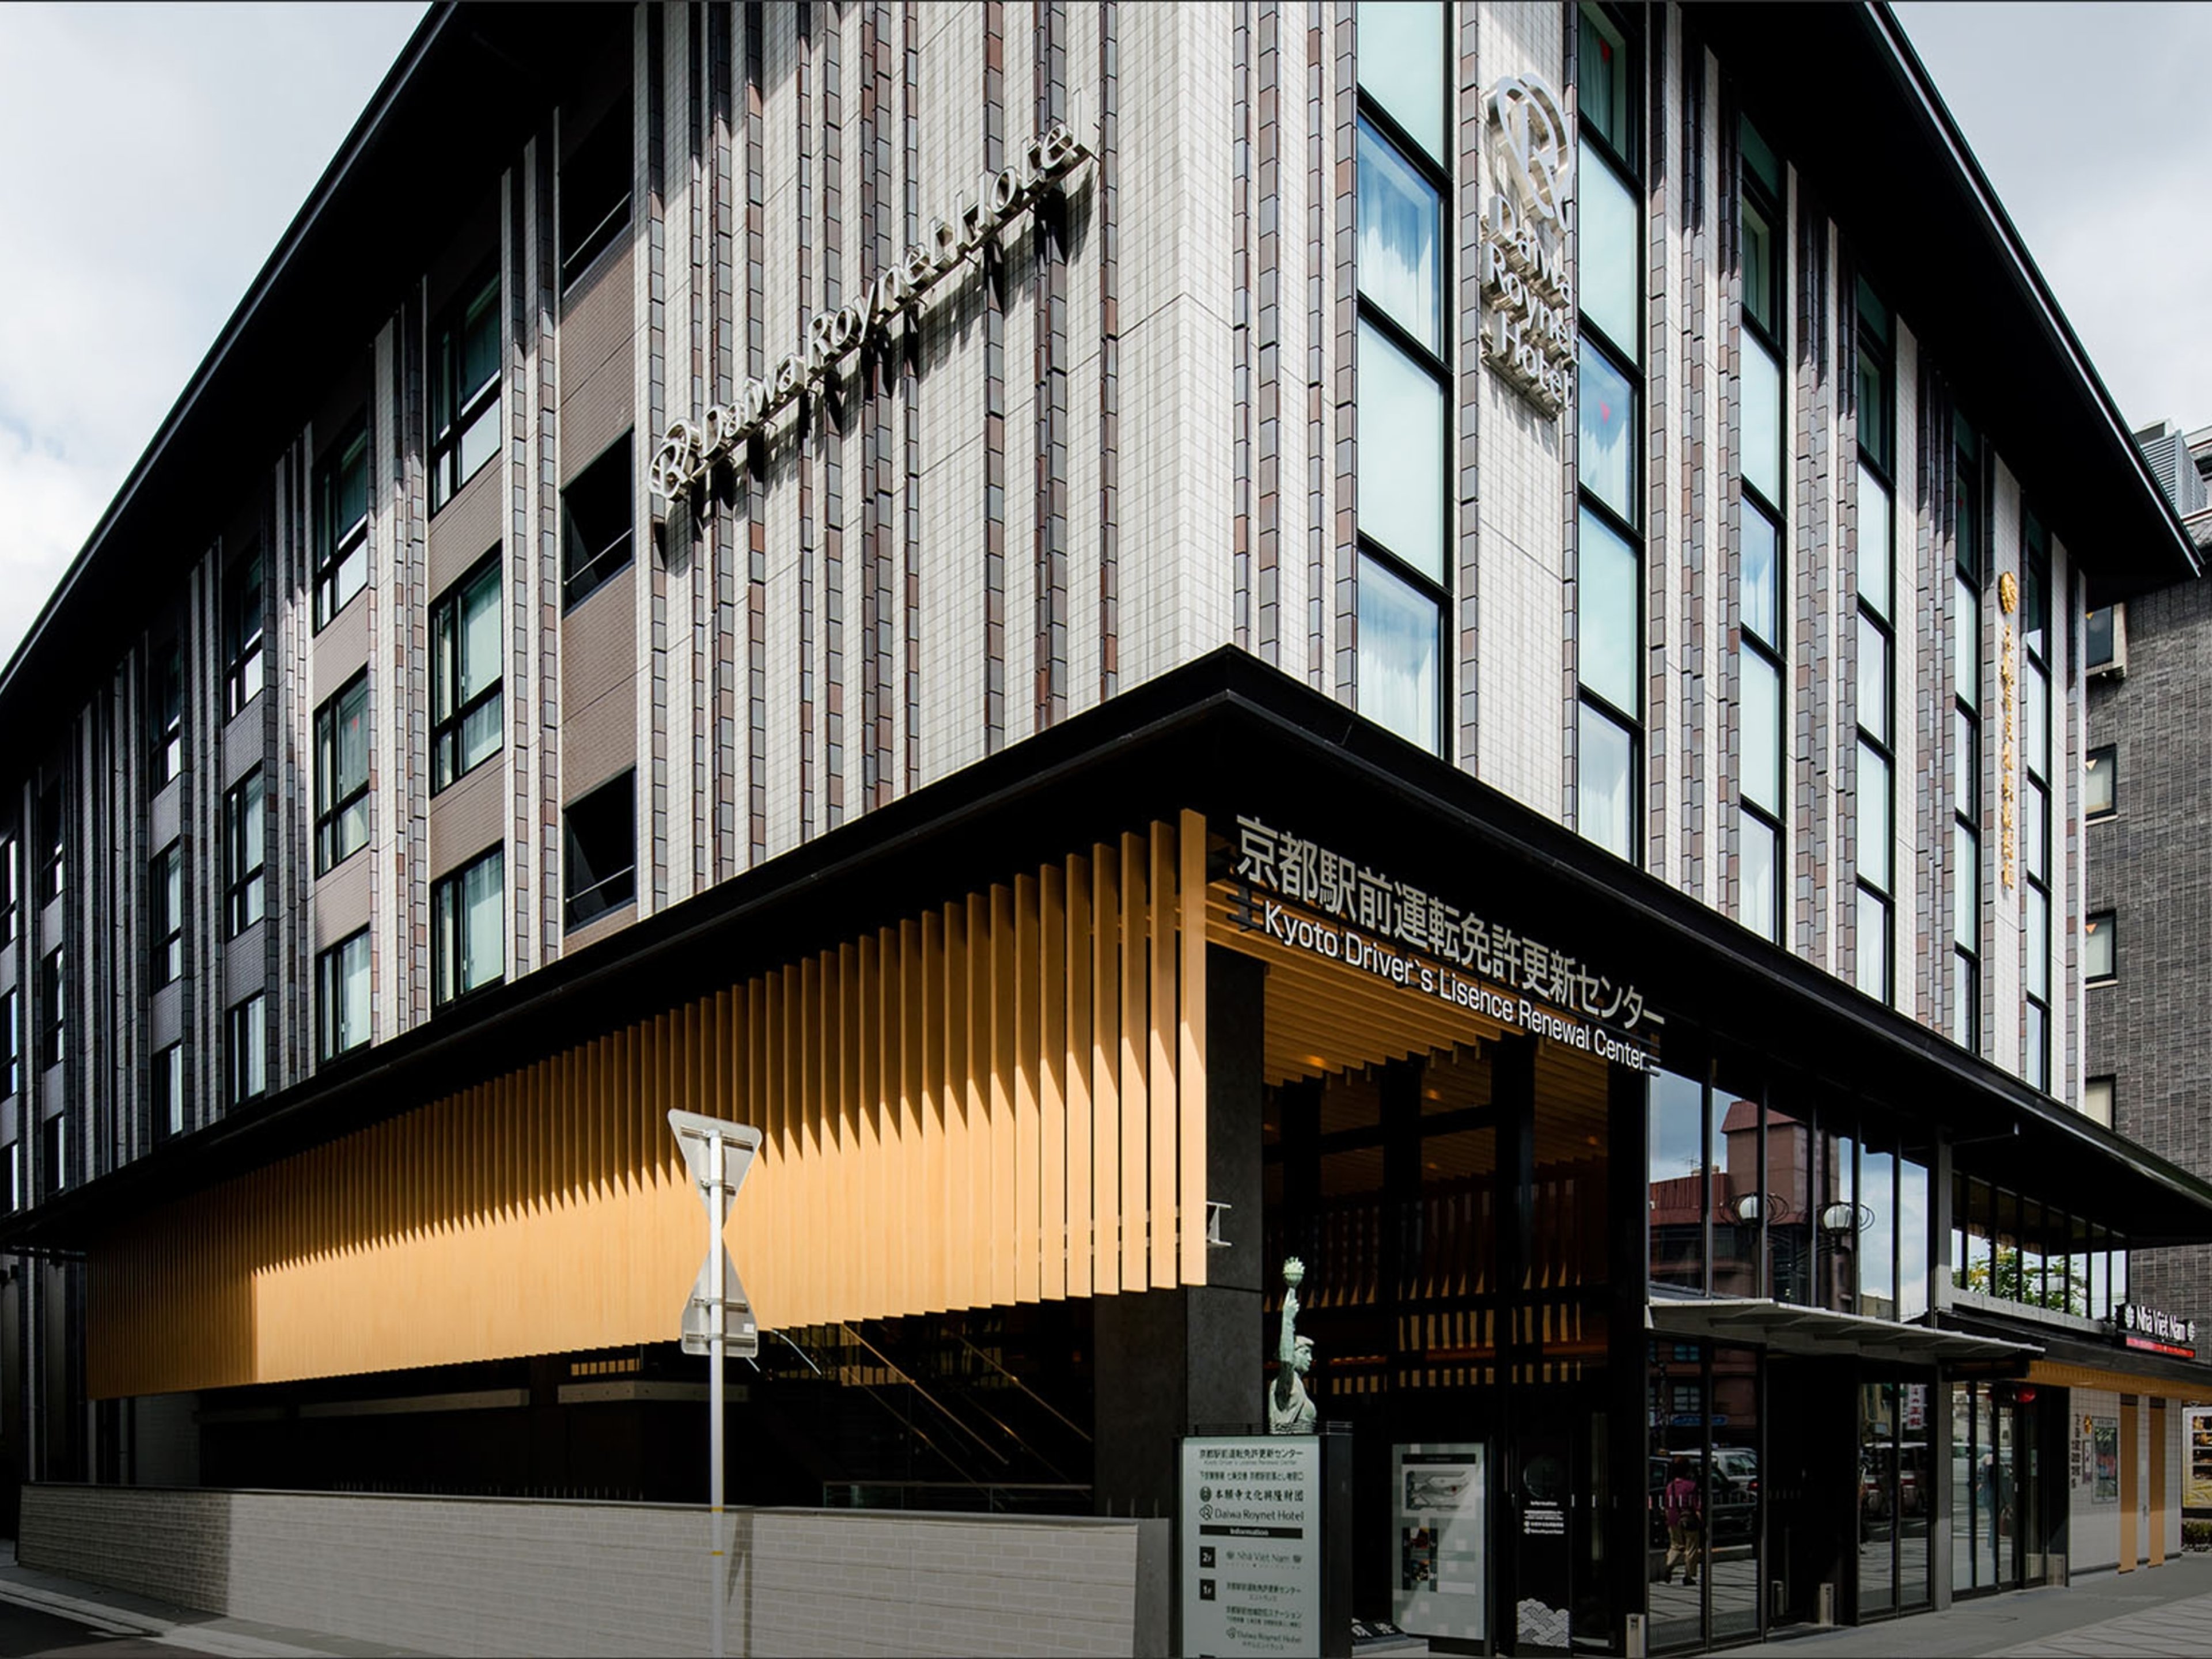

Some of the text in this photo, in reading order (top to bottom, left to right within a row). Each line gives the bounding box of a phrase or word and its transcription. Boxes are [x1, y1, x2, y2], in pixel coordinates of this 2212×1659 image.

[701, 353, 806, 460] Daiwa
[808, 215, 952, 373] Roynet
[1237, 815, 1665, 1030] 京都駅前運転免許更新センター
[1265, 900, 1338, 958] Kyoto
[1440, 967, 1514, 1022] Lisence
[1518, 998, 1590, 1051] Renewal
[1593, 1029, 1647, 1070] Center
[1214, 1508, 1304, 1522] Daiwa Roynet Hotel
